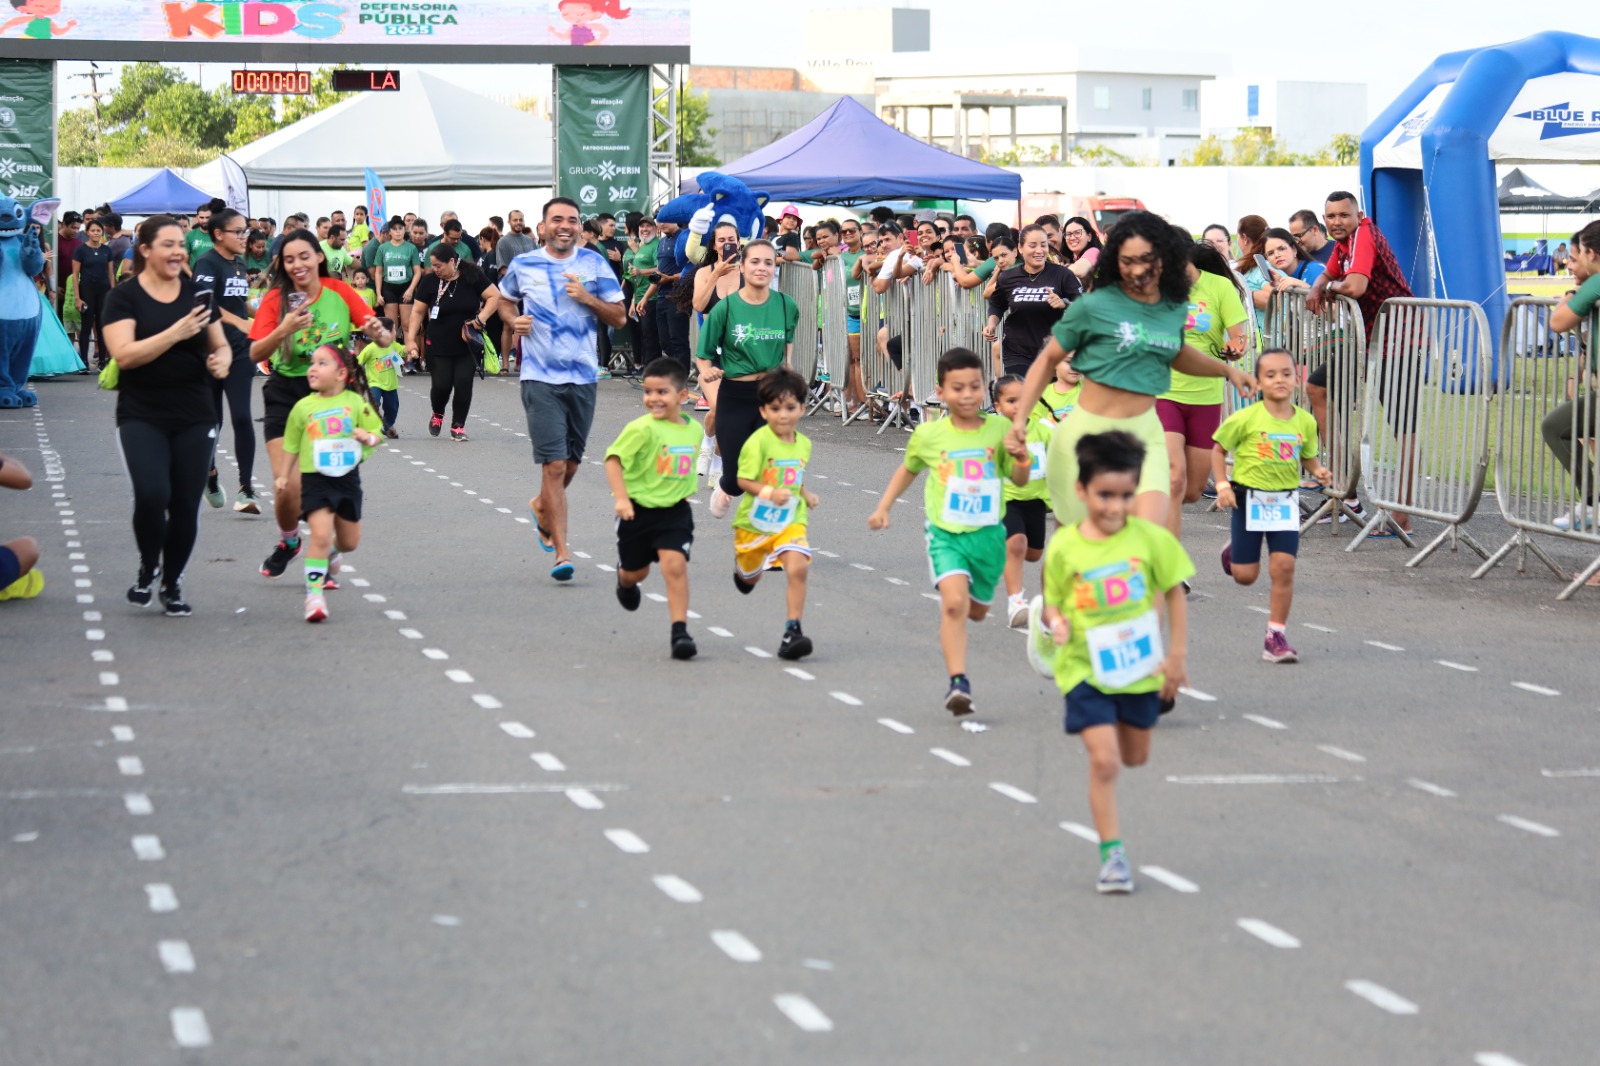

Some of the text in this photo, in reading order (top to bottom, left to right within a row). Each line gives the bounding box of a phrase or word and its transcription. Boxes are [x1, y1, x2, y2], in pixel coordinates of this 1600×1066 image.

[360, 2, 457, 11] DEFENSORIA
[163, 1, 347, 39] KIDS
[359, 10, 458, 25] PÚBLICA
[386, 25, 429, 35] 2025
[233, 72, 308, 91] 00:00:00
[591, 98, 623, 106] Realização
[1533, 110, 1584, 121] BLUE
[569, 166, 641, 175] GRUPO PERIN
[329, 452, 344, 466] 91
[656, 454, 692, 476] KID
[958, 495, 983, 513] 170
